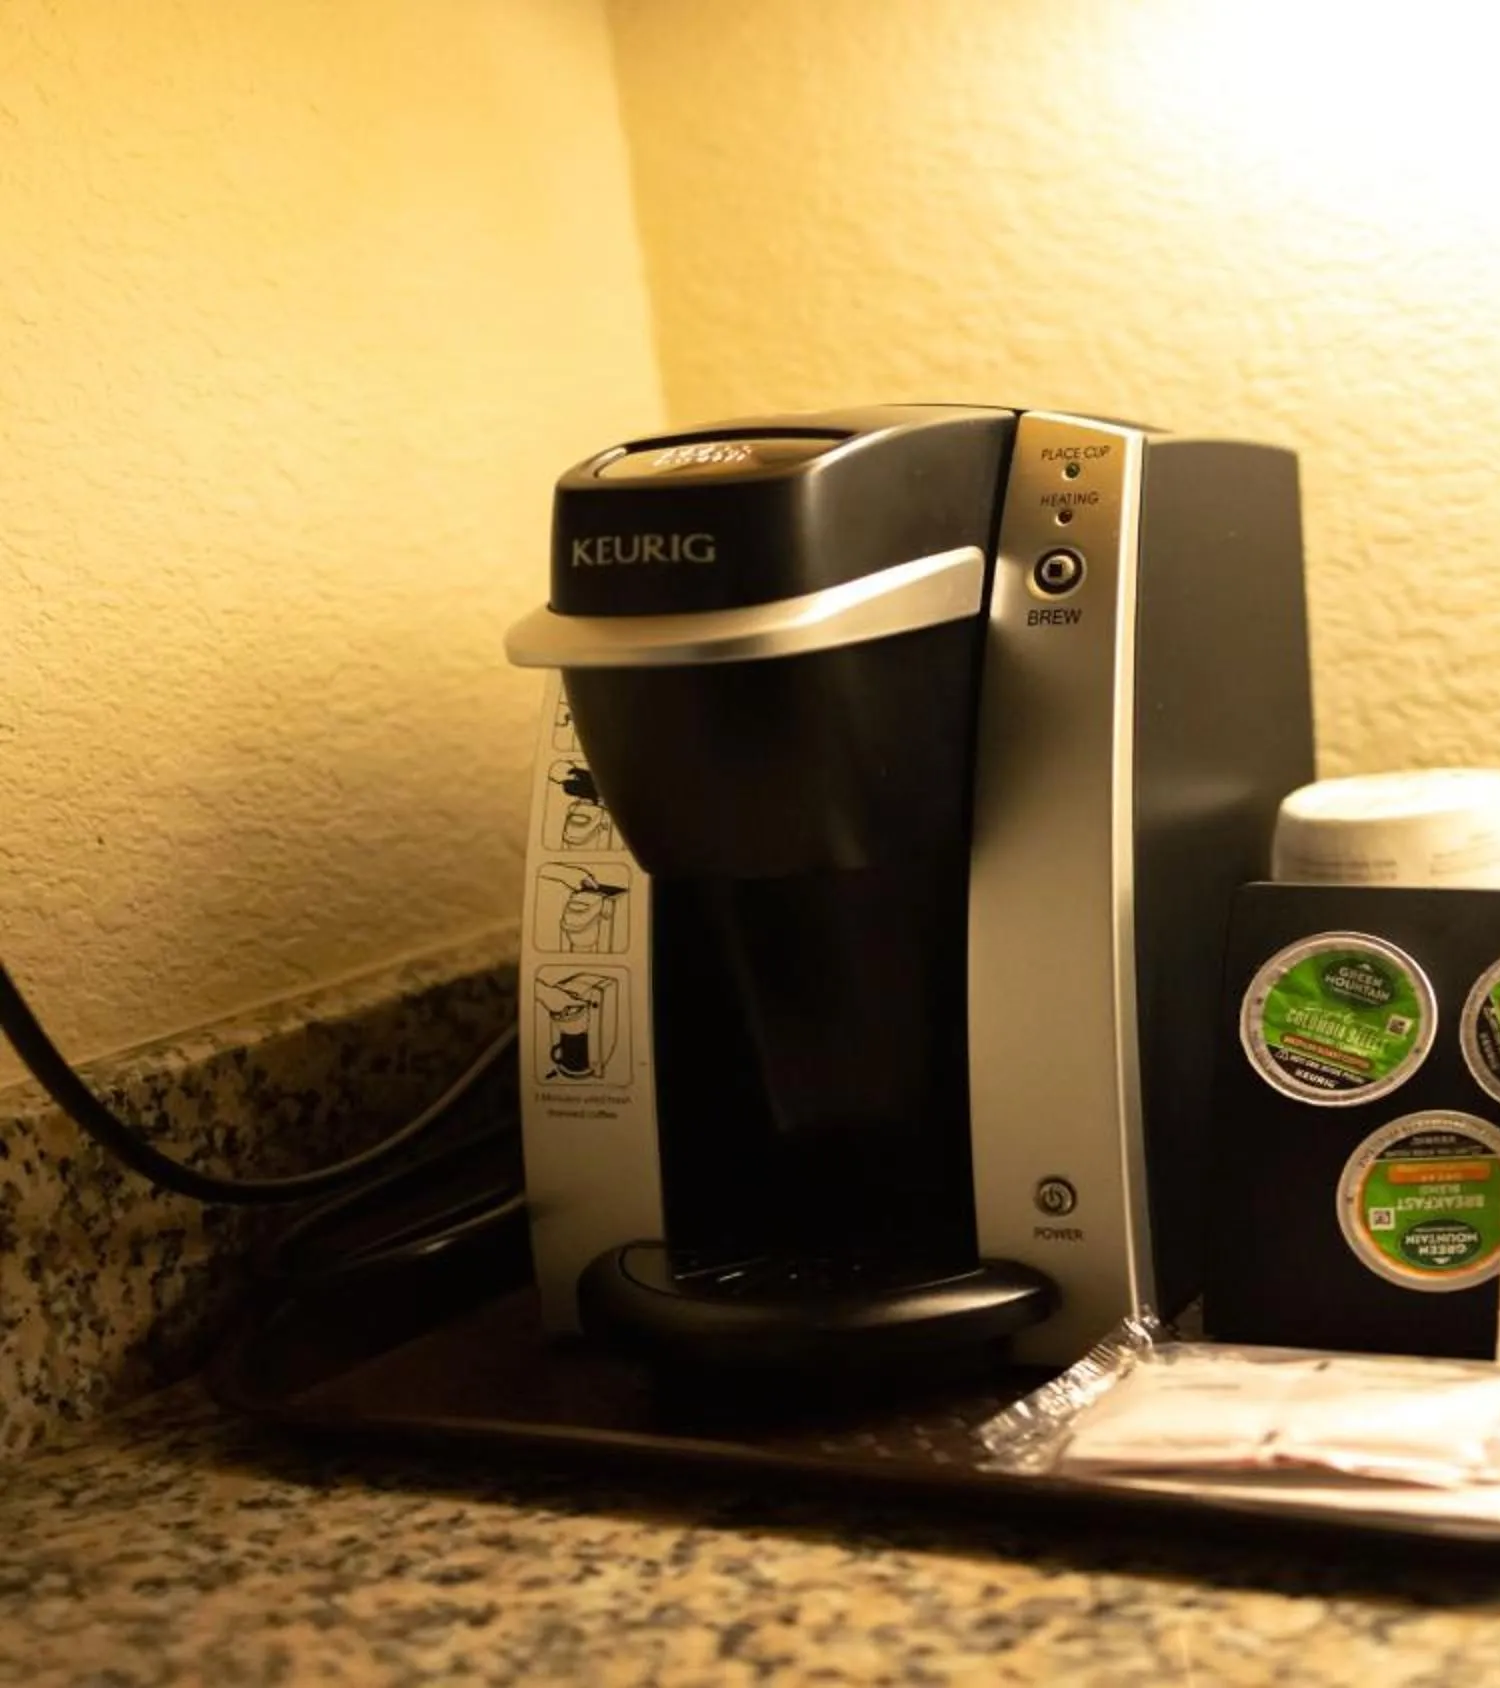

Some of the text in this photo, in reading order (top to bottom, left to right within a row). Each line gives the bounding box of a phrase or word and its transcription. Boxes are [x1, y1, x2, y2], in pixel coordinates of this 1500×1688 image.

[1041, 445, 1112, 461] PLACE CUP
[1040, 491, 1099, 507] HEATING
[571, 533, 716, 568] KEURIG
[1027, 608, 1082, 627] BREW
[1339, 967, 1384, 988] GREEN
[1325, 975, 1391, 1001] MOUNTAIN
[1396, 1194, 1486, 1211] BREAKFAST
[1033, 1226, 1085, 1241] POWER
[1405, 1231, 1478, 1245] MOUNTAIN
[1419, 1244, 1467, 1256] GREEN
